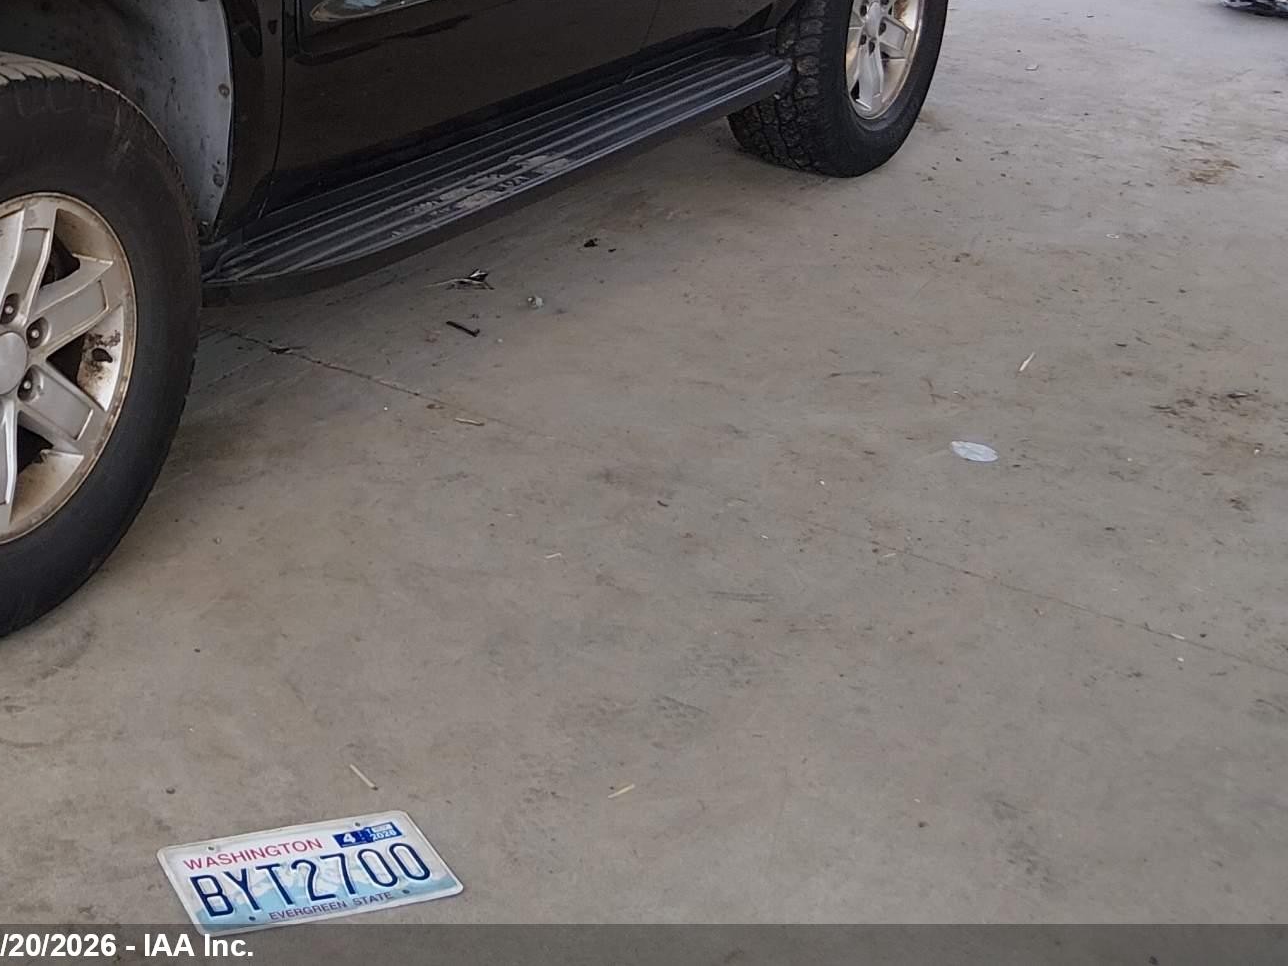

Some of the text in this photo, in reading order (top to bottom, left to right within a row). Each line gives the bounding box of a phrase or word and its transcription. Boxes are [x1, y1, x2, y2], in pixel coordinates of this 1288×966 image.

[342, 833, 357, 843] 4
[183, 838, 323, 871] WASHINGTON
[189, 842, 431, 917] BYT2700
[268, 890, 394, 920] EVERGREEN STATE
